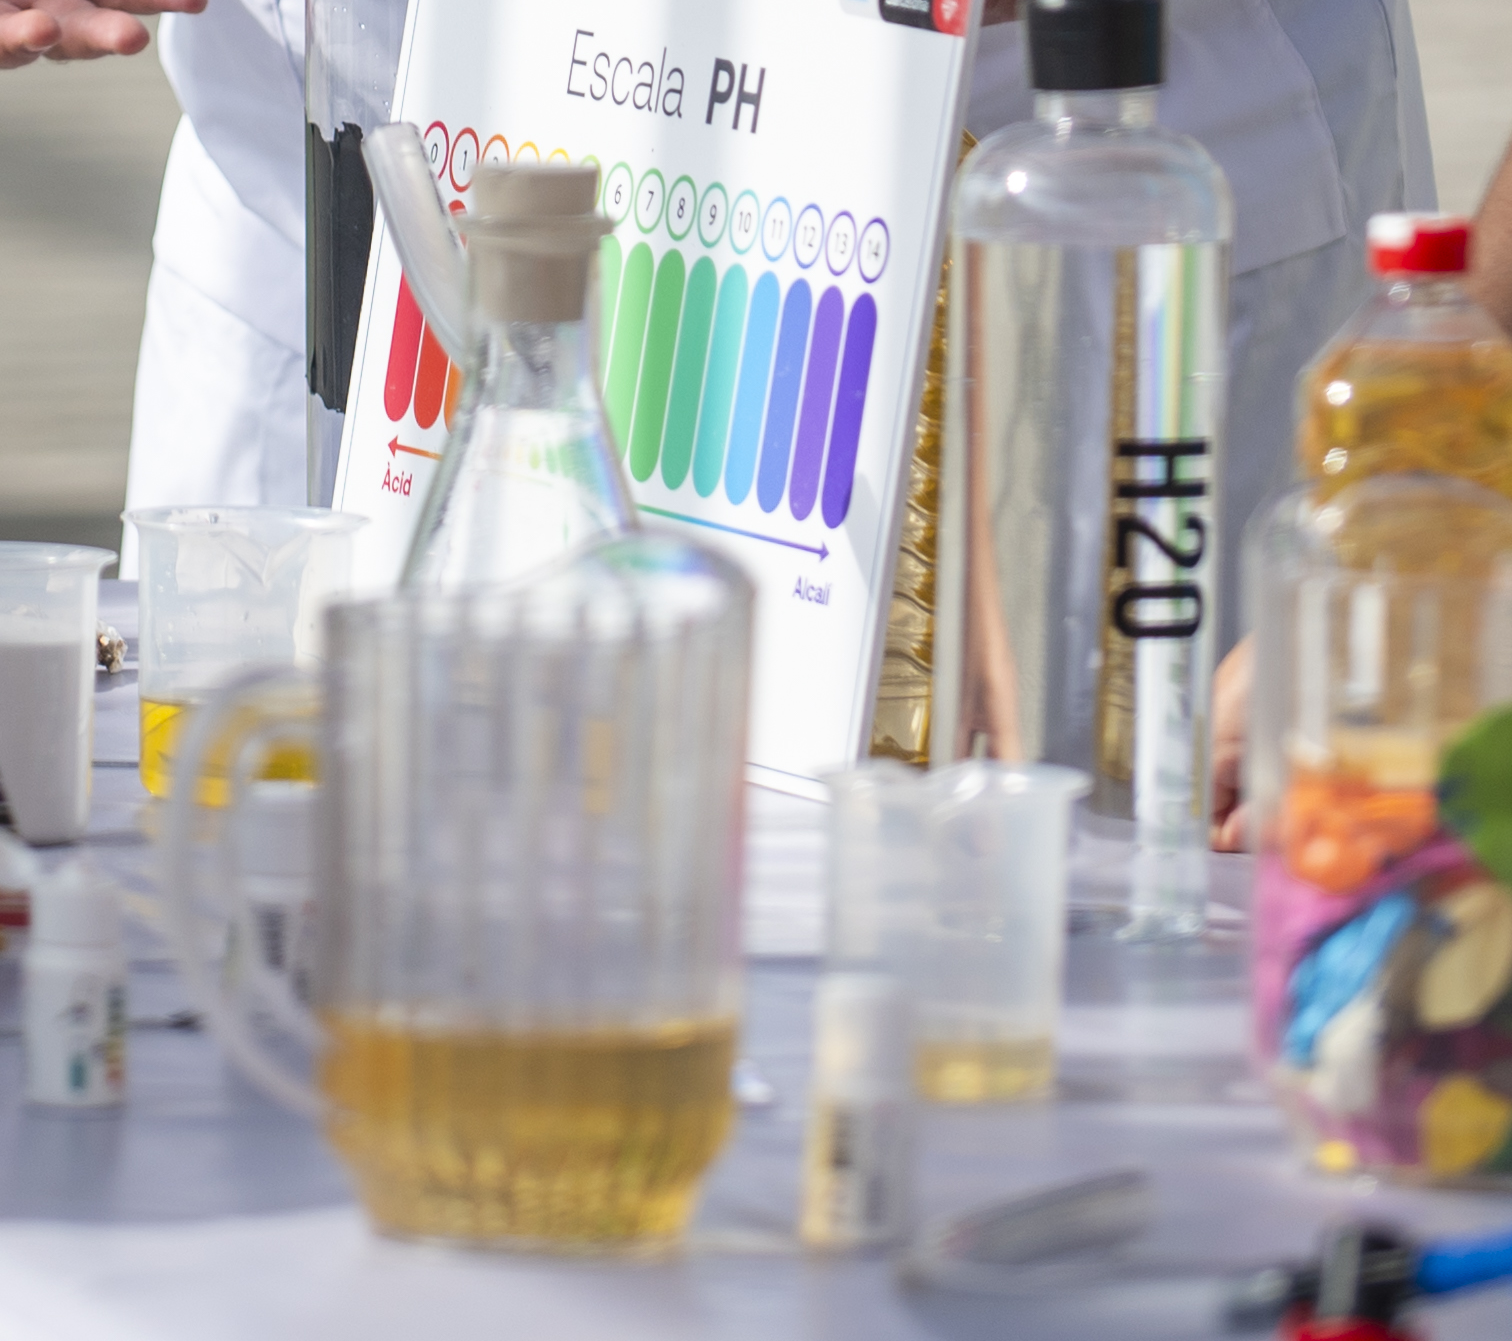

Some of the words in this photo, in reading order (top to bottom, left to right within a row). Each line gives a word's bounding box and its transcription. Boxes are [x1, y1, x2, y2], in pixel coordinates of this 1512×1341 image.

[566, 28, 685, 119] Escala
[705, 56, 767, 134] PH
[430, 142, 439, 164] 0
[614, 184, 623, 205] 6
[646, 190, 654, 211] 7
[676, 197, 685, 219] 8
[708, 204, 717, 226] 9
[738, 210, 752, 234] 10
[771, 217, 783, 241] 11
[802, 224, 816, 248] 12
[835, 231, 848, 255] 13
[867, 238, 881, 258] 14
[381, 461, 413, 497] Àcid
